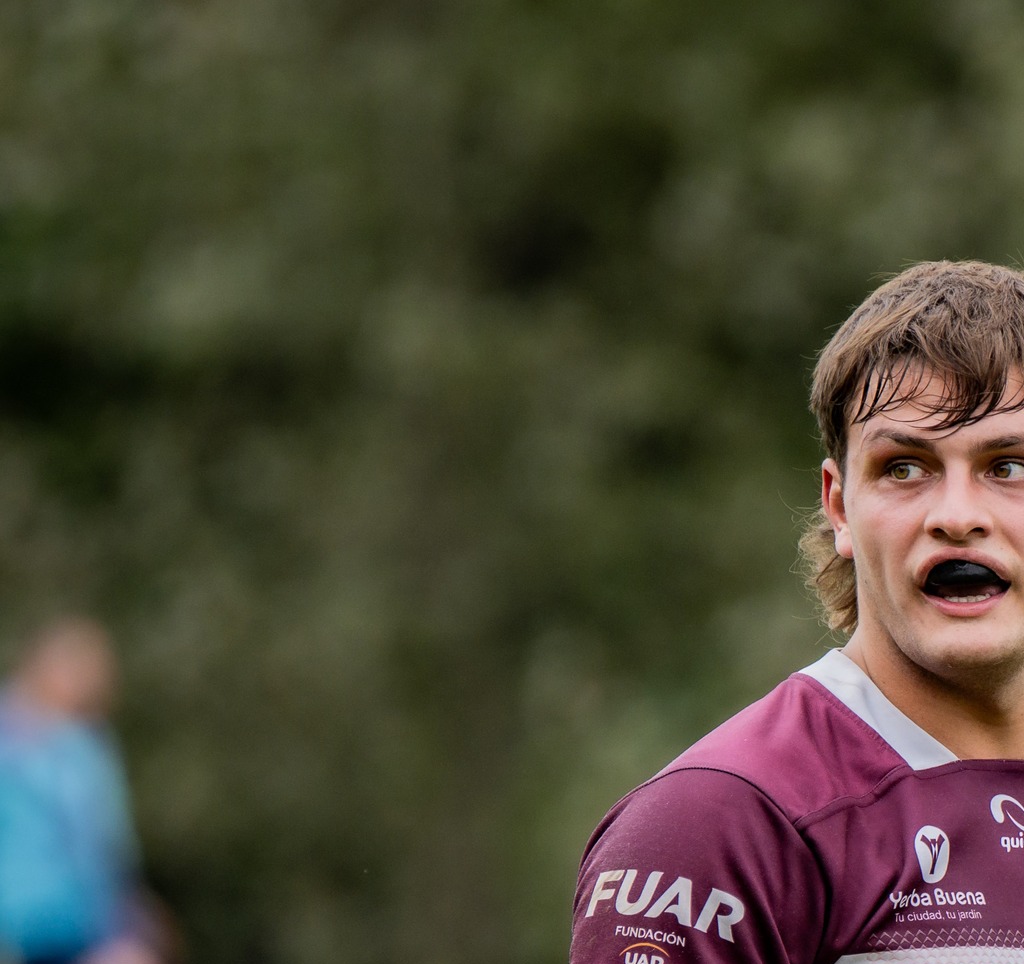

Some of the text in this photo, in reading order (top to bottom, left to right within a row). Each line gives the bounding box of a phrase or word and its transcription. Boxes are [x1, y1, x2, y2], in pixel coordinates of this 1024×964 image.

[585, 868, 745, 943] FUAR
[933, 887, 987, 906] Buena
[907, 910, 945, 922] ciudad,
[946, 910, 956, 920] tu
[615, 925, 686, 947] FUNDACIÓN
